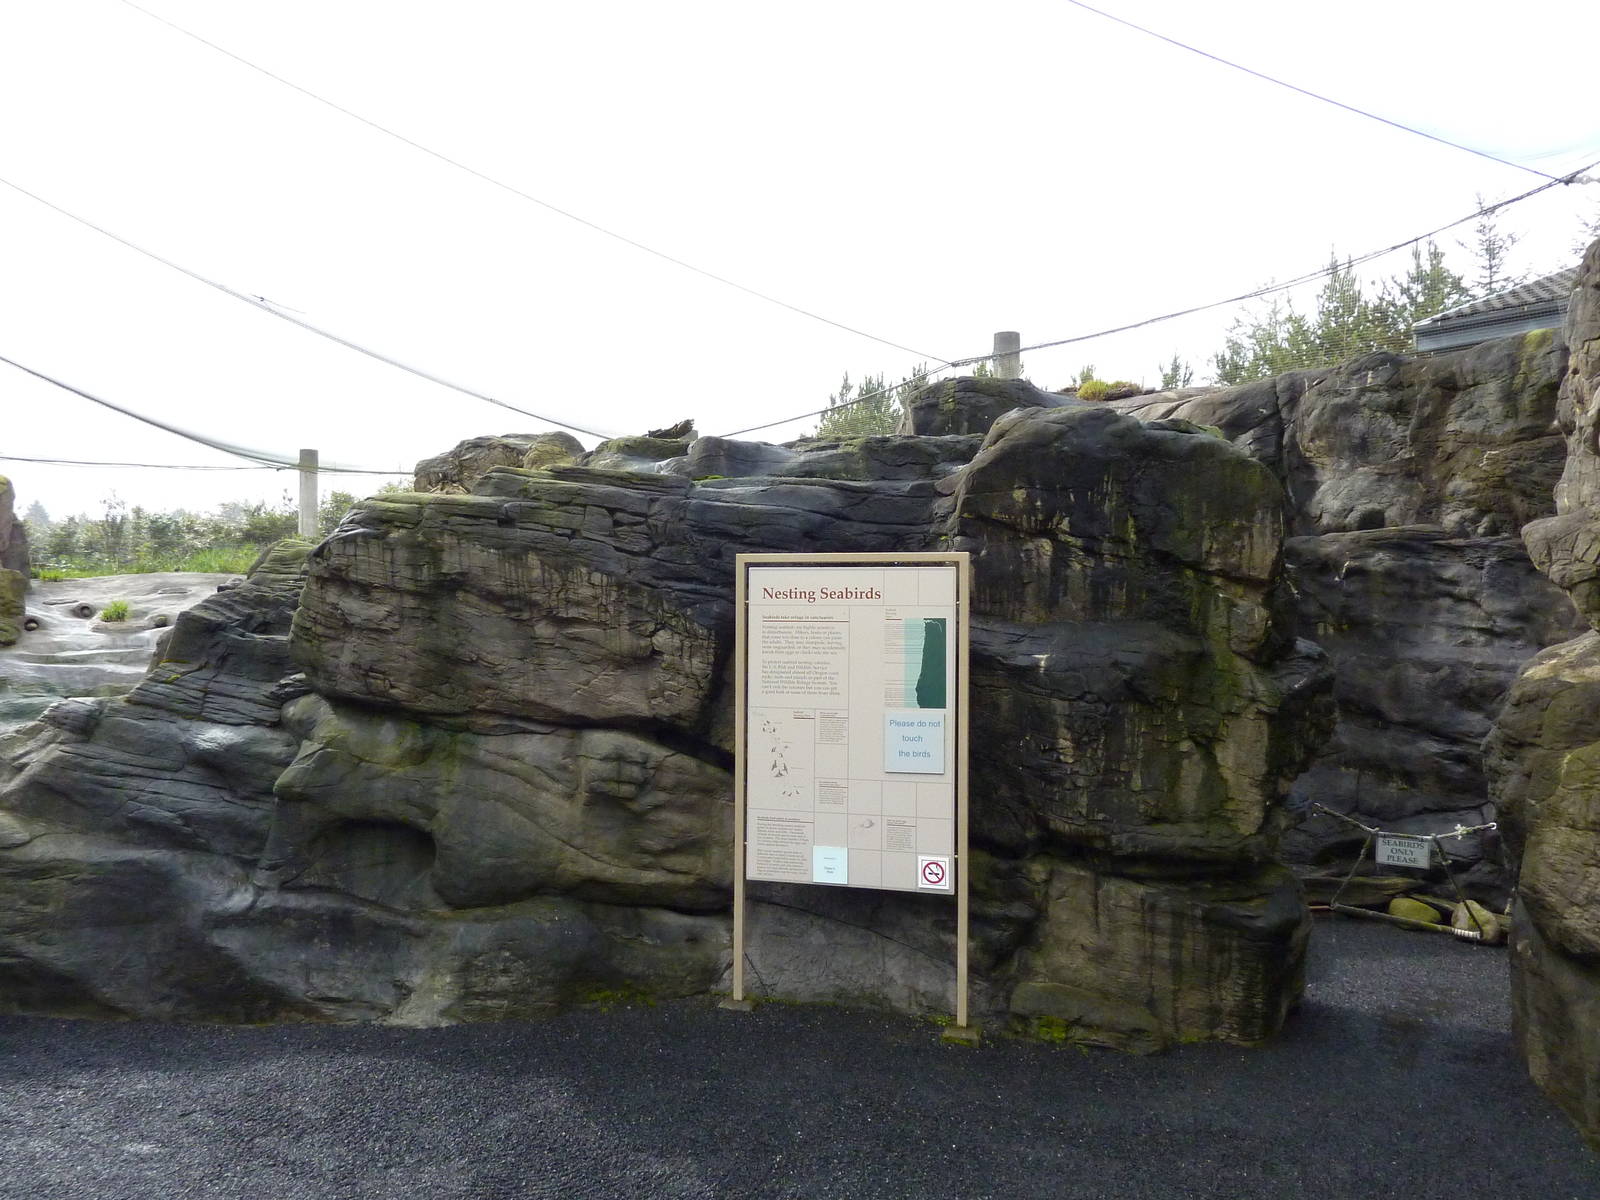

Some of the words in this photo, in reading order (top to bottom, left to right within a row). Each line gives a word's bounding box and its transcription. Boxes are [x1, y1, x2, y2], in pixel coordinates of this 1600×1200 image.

[763, 587, 816, 603] Nesting
[820, 587, 881, 600] Seabirds
[889, 719, 915, 727] Please
[917, 719, 927, 727] do
[929, 720, 941, 728] not
[902, 735, 923, 743] touch
[898, 750, 911, 758] the
[912, 750, 931, 758] birds
[1382, 839, 1425, 850] SEABIRDS
[1390, 847, 1414, 856] ONLY
[1387, 855, 1417, 864] PLEASE
